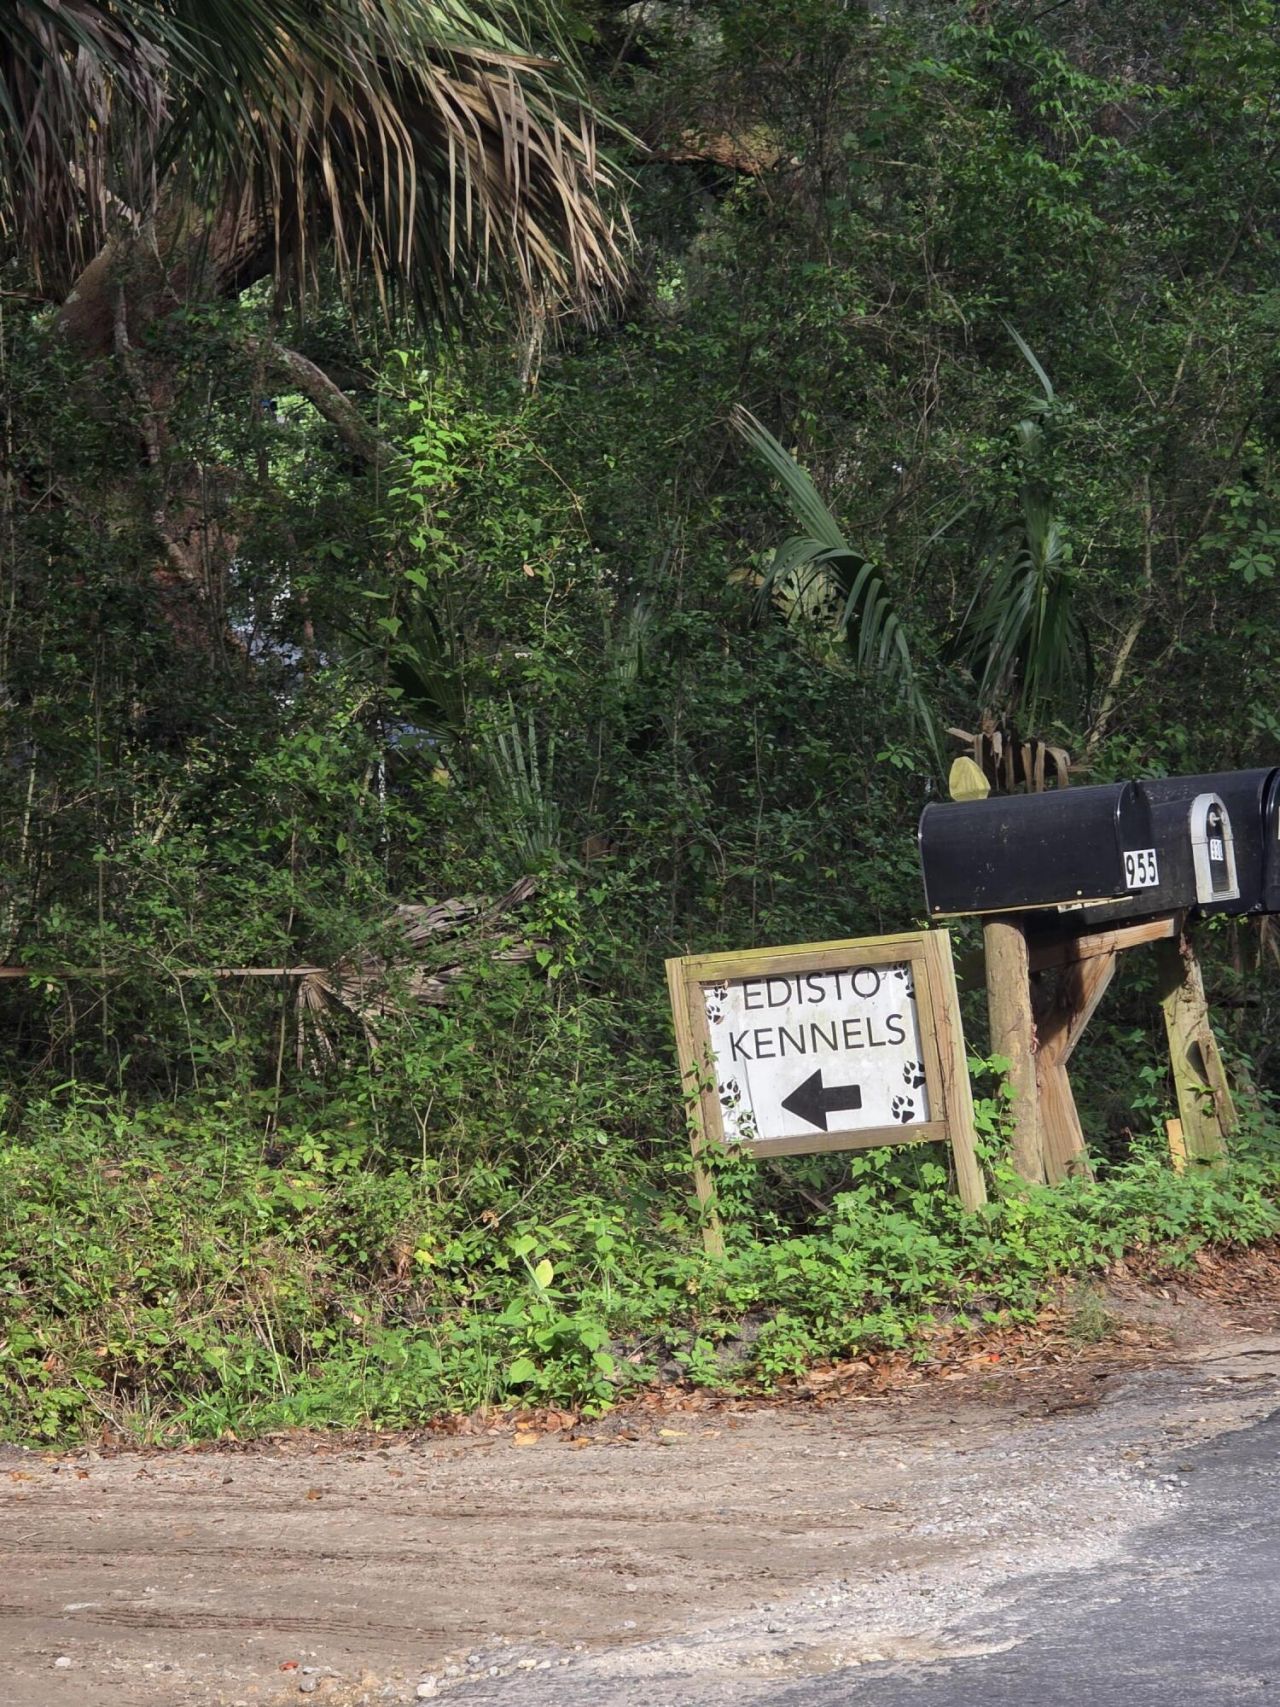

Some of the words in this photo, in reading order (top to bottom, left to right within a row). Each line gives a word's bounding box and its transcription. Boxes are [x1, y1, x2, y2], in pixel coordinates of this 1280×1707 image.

[1126, 852, 1156, 886] 955
[742, 966, 881, 1010] EDISTO
[729, 1013, 907, 1062] KENNELS
